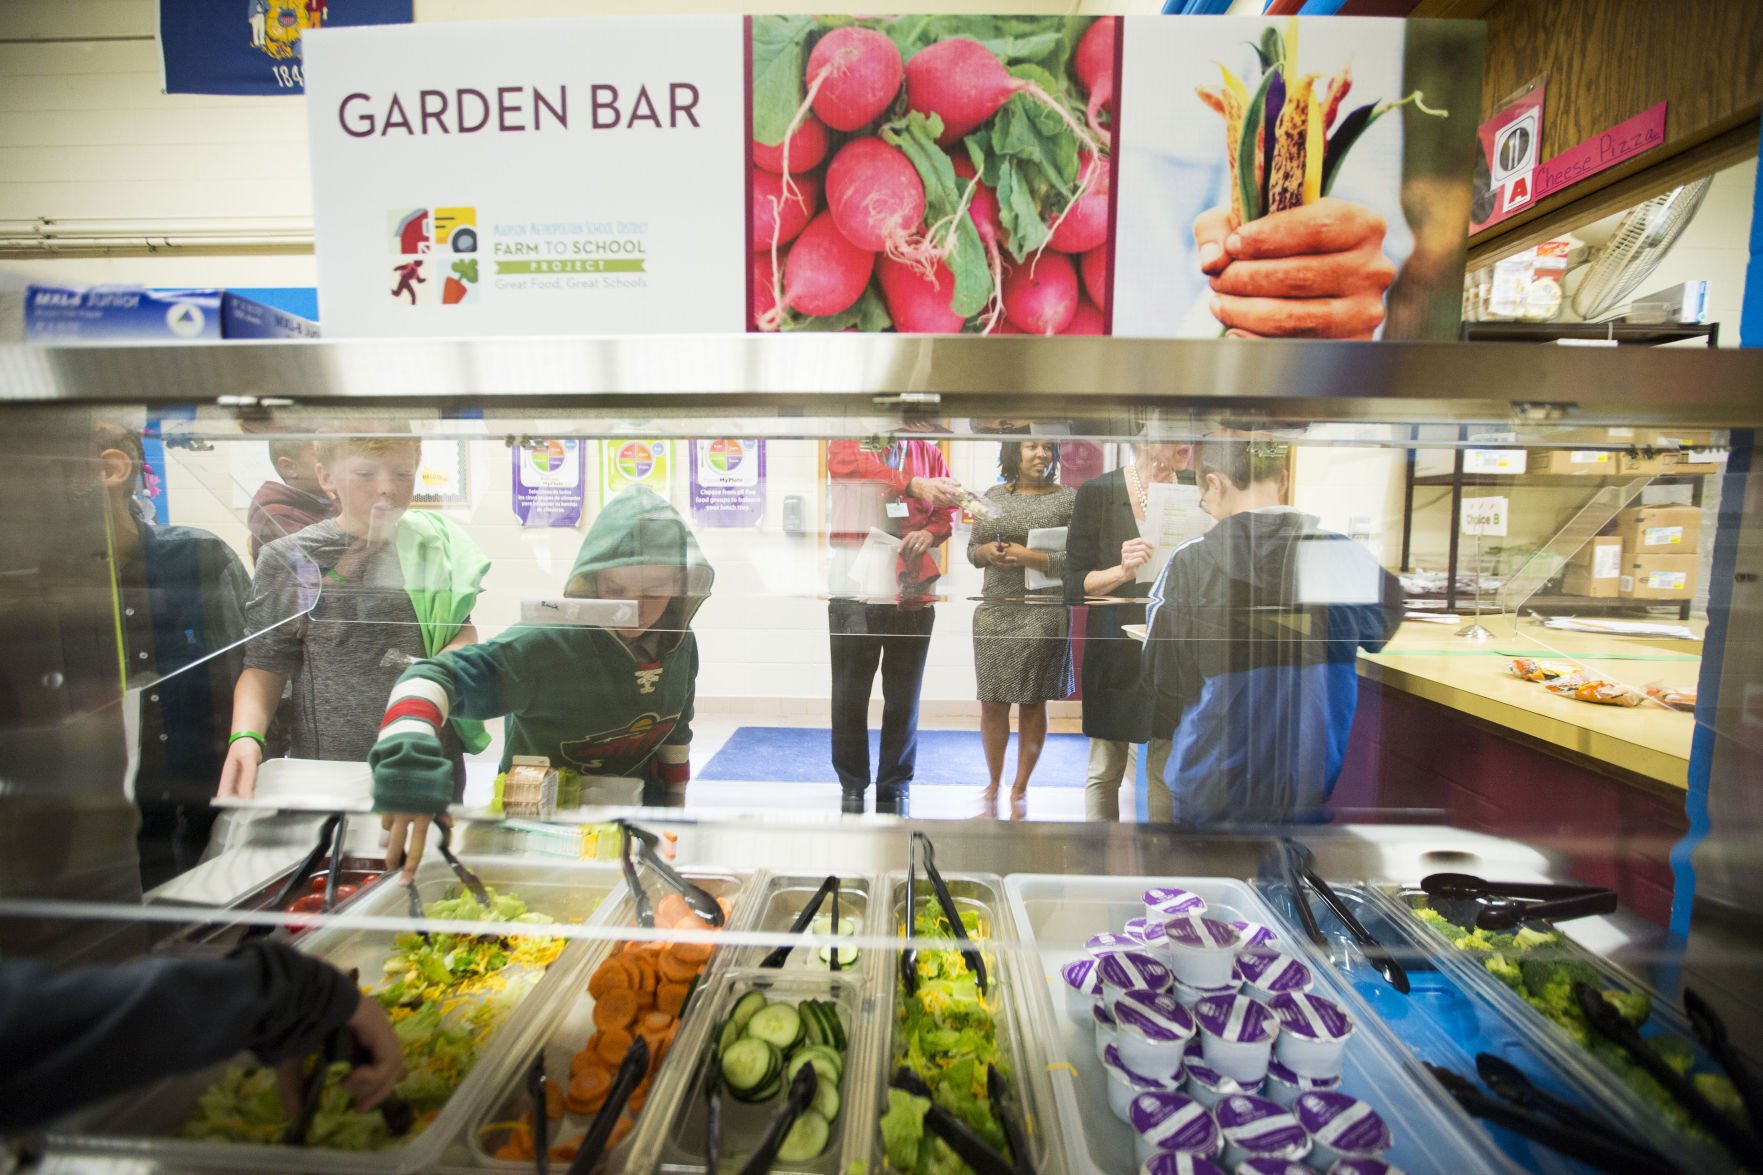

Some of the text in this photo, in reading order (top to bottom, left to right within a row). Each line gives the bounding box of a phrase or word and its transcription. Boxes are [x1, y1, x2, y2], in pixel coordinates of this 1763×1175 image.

[271, 64, 305, 88] 184
[338, 82, 701, 138] GARDEN BAR
[1534, 128, 1661, 195] Cheese Pizza
[1509, 176, 1529, 204] A
[495, 240, 646, 255] FARM TO SCHOOL
[530, 261, 605, 272] PROJECT
[495, 279, 528, 289] Great
[566, 277, 601, 289] Great
[604, 276, 648, 288] Schools
[1493, 513, 1500, 525] B
